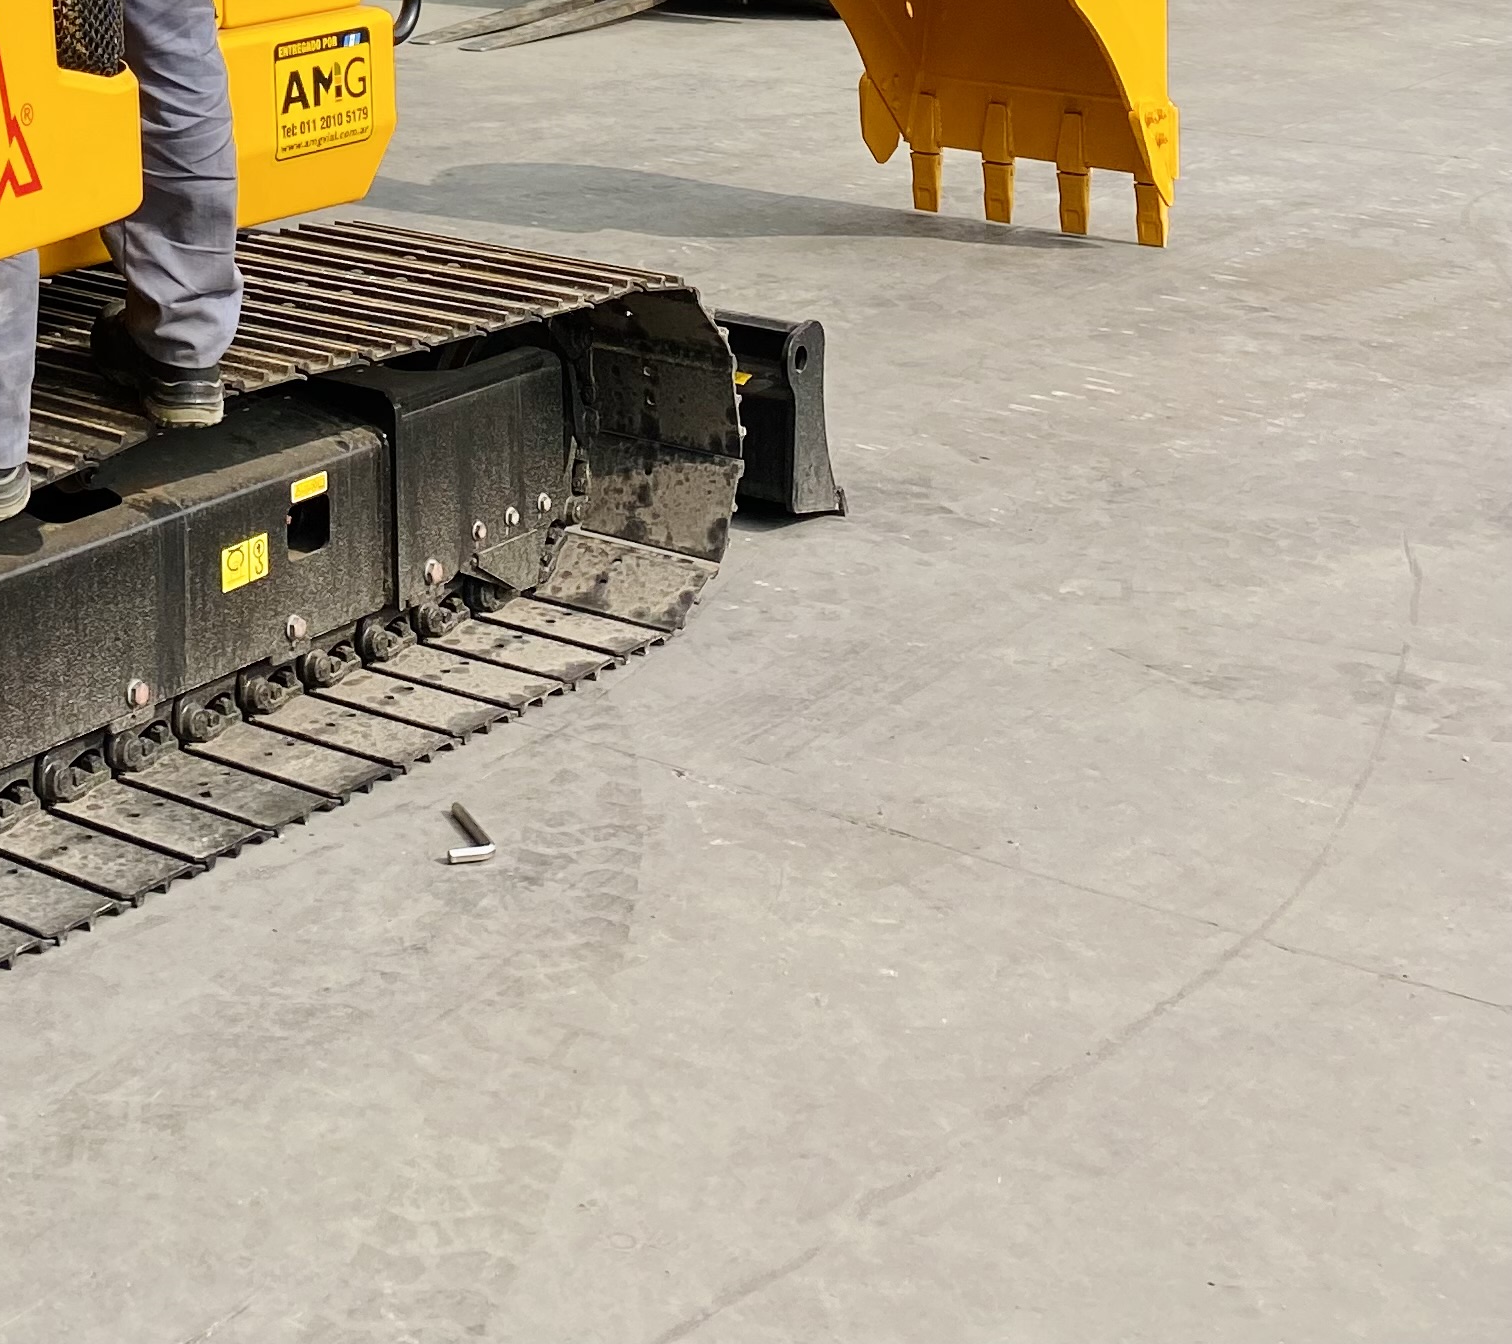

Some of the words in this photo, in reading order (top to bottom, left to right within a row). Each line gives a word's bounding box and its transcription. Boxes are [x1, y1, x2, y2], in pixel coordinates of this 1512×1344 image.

[278, 39, 321, 57] ENTREGADO
[322, 35, 338, 49] POR
[281, 56, 367, 115] AMG
[300, 118, 317, 135] 011
[320, 112, 343, 130] 2010
[345, 106, 369, 123] 5179
